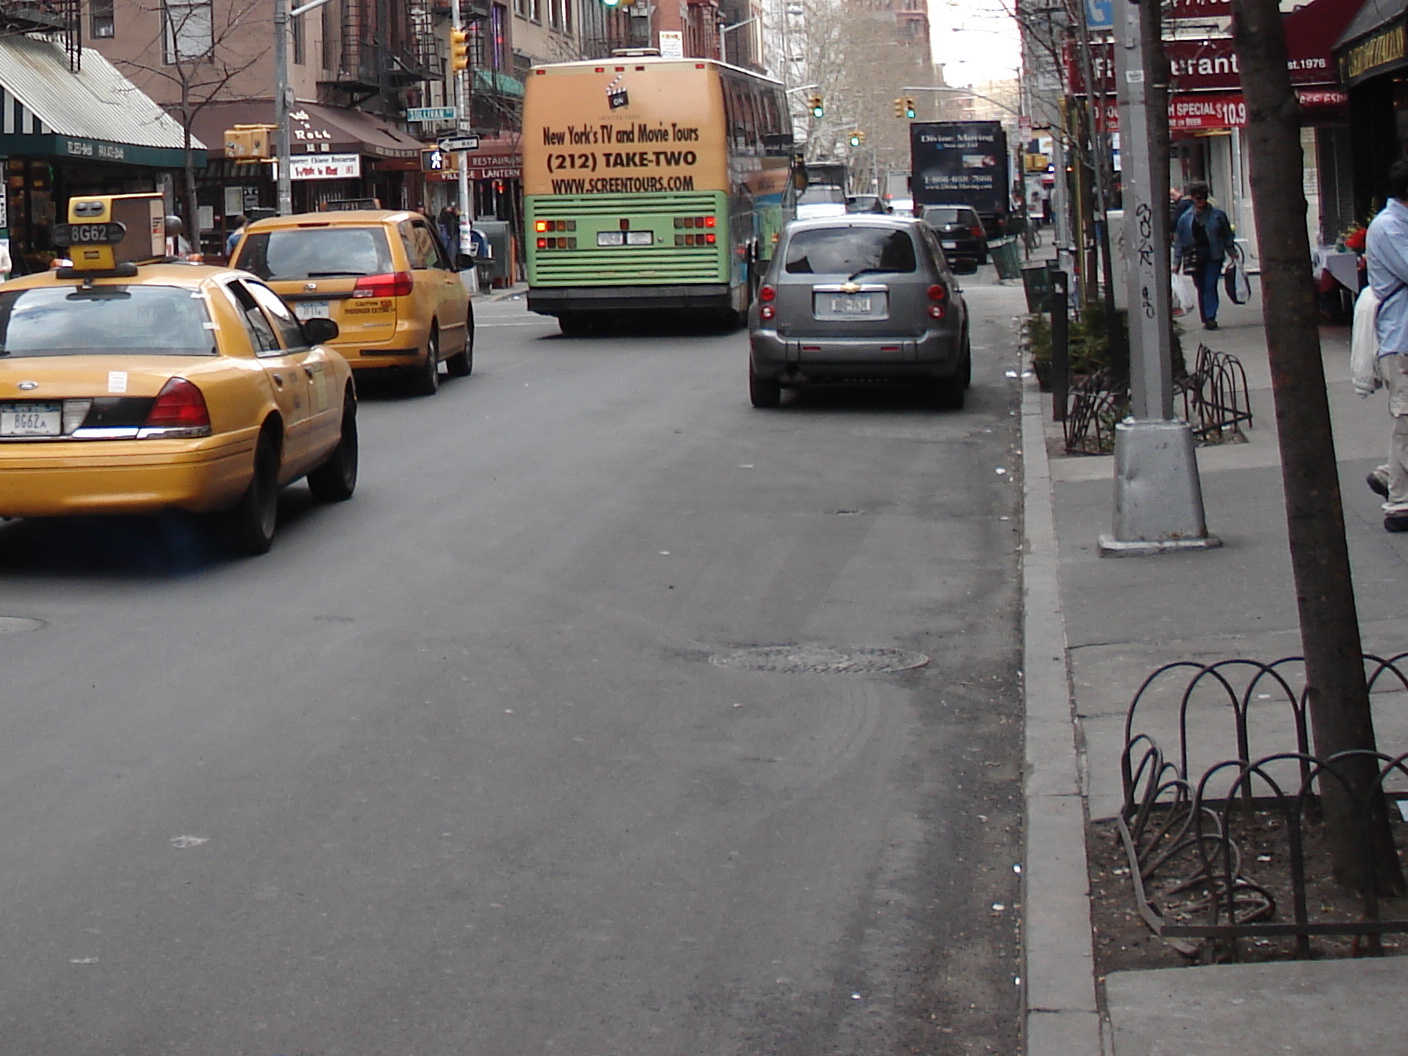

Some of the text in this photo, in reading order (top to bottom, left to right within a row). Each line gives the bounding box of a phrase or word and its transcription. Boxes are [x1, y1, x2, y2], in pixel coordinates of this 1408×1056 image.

[613, 97, 624, 106] ON
[1177, 103, 1216, 117] SPECIAL
[543, 121, 699, 146] New York's TV and Movie Tours
[547, 151, 697, 173] (212) TAKE-TWO
[441, 169, 520, 180] VILLGE LANTERN
[552, 175, 695, 195] WWW.SCREENTOURS.COM
[71, 225, 107, 241] 8G62
